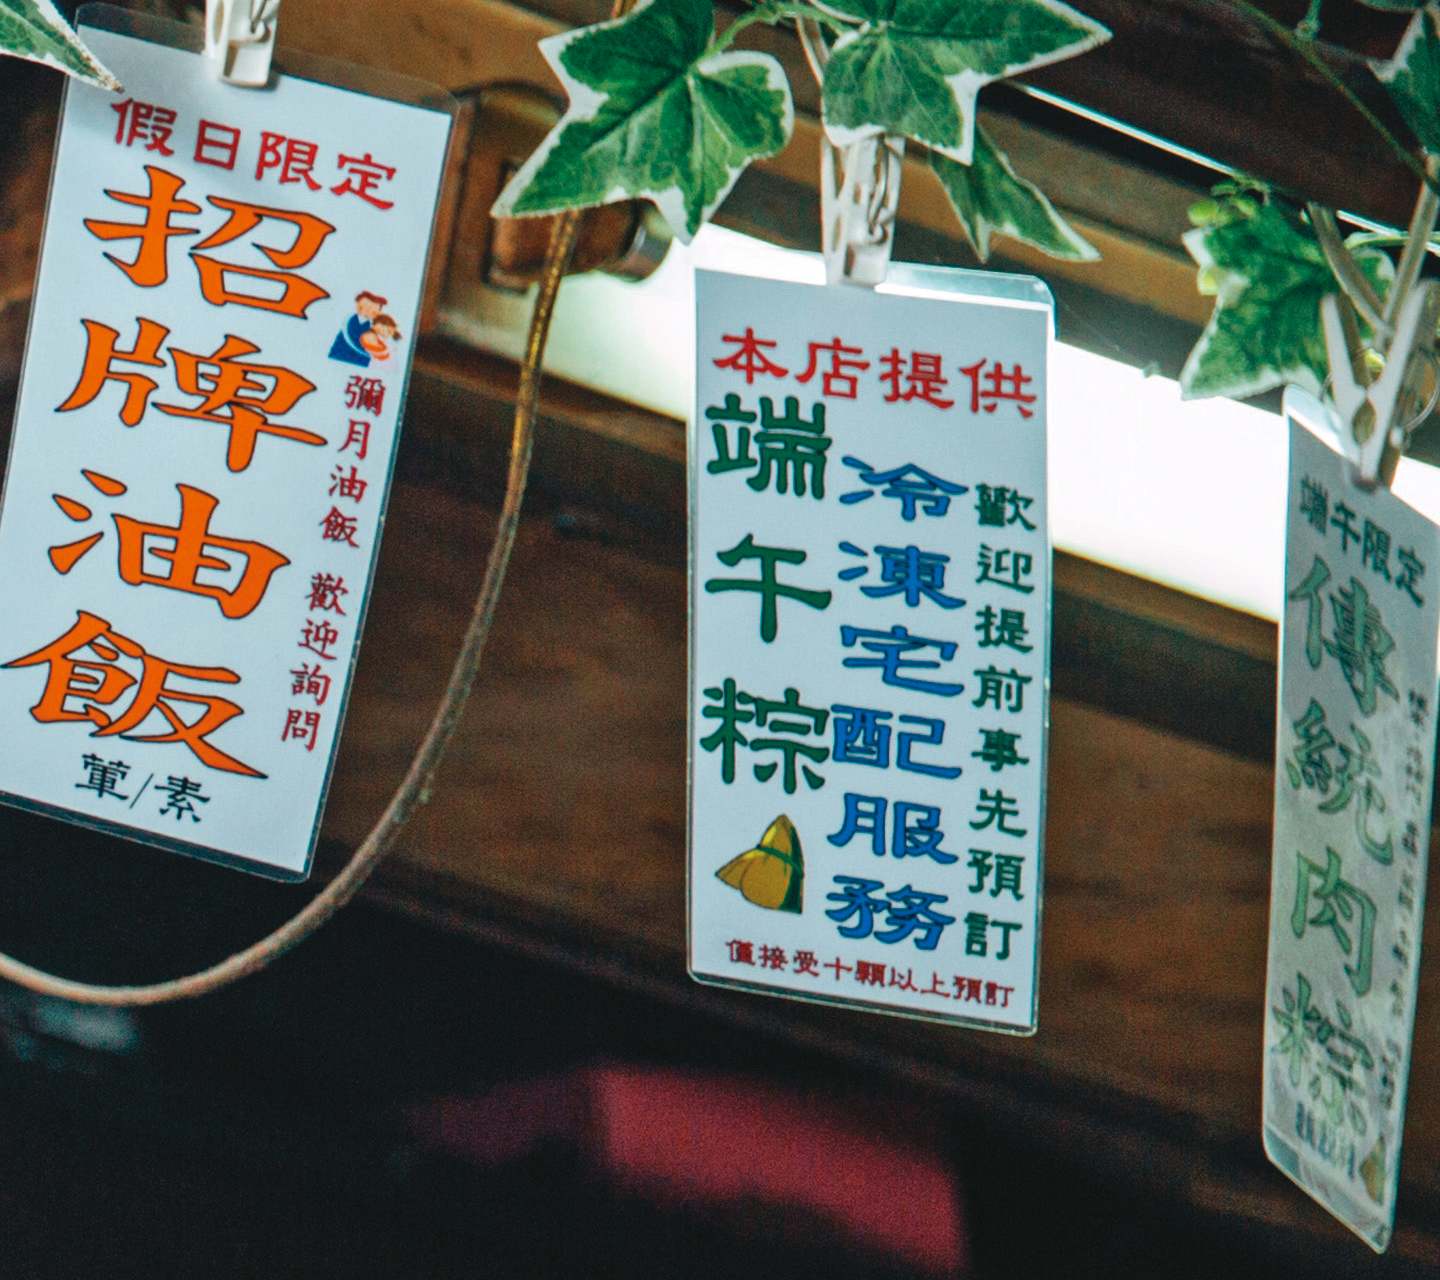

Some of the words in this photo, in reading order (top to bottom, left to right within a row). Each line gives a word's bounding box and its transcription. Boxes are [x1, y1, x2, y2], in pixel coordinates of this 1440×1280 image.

[111, 95, 397, 213] 假日限定
[319, 374, 387, 549] 彌月油飯
[713, 326, 1039, 420] 本店提供
[0, 164, 337, 780] 招牌油飯
[1299, 473, 1426, 609] 端午限定
[280, 571, 350, 752] 歡迎詢問
[699, 393, 834, 794] 端午粽
[74, 752, 211, 823] 葷/素
[825, 454, 969, 952] 冷凍宅配服務
[965, 480, 1039, 963] 歡迎提前事先預訂
[1271, 553, 1400, 1136] 傳統肉粽
[725, 938, 1016, 1008] 僅接受十顆以上預訂
